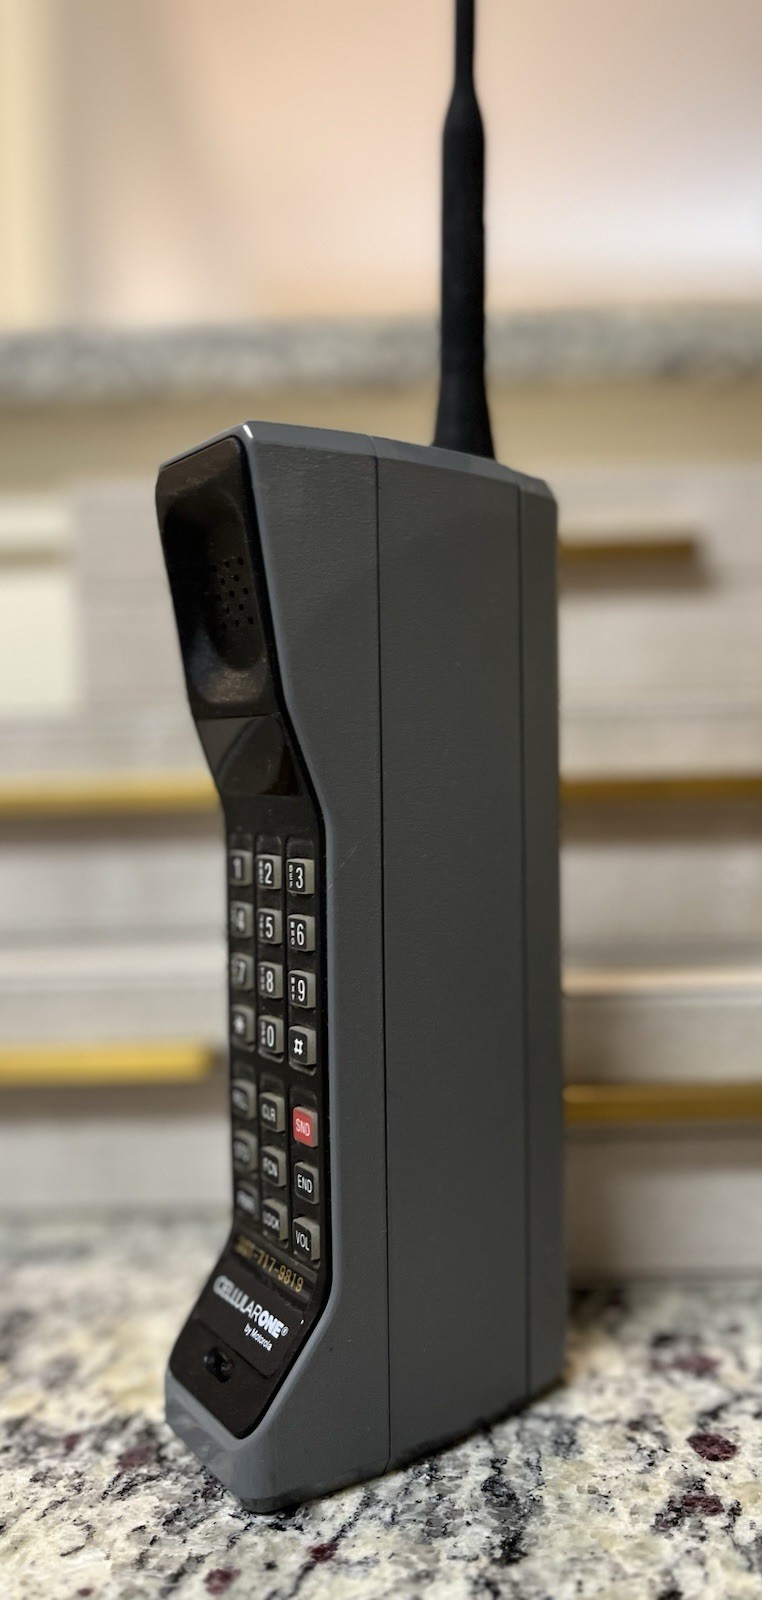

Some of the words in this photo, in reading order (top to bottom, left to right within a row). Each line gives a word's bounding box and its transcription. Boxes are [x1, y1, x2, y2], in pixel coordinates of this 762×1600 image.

[264, 862, 273, 884] 2
[295, 867, 304, 889] 3
[265, 916, 274, 938] 5
[296, 923, 305, 946] 6
[266, 970, 274, 993] 8
[297, 979, 306, 1002] 9
[266, 1025, 275, 1047] 0
[293, 1038, 303, 1056] #
[295, 1118, 311, 1137] SND
[297, 1173, 313, 1194] END
[295, 1229, 310, 1252] VOL
[243, 1323, 252, 1336] by
[250, 1328, 273, 1352] Motorola
